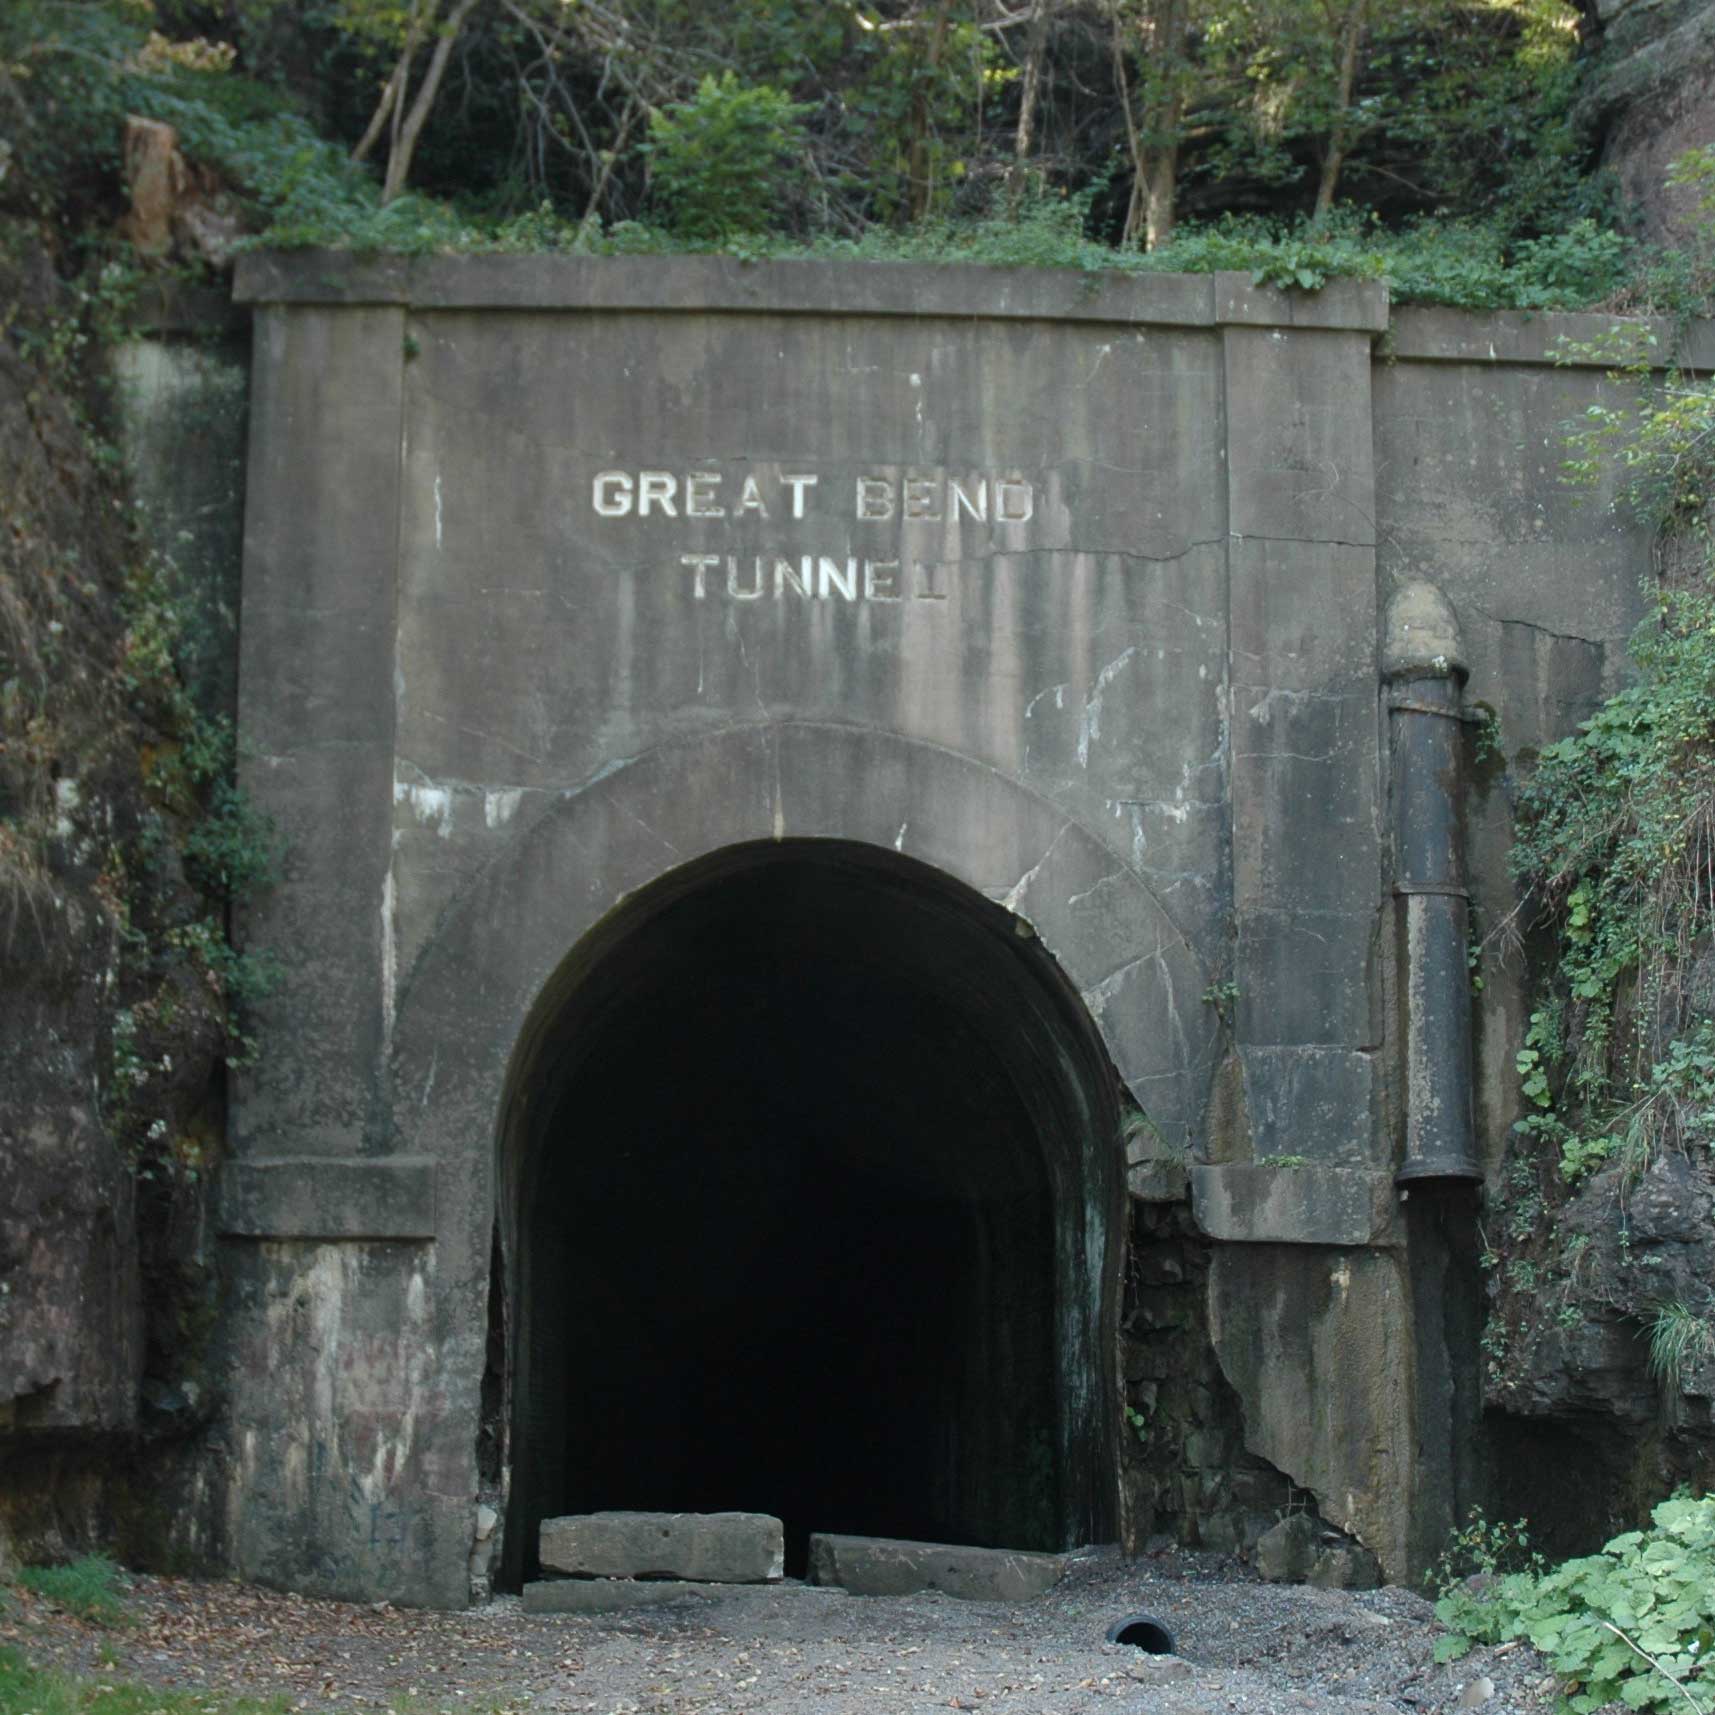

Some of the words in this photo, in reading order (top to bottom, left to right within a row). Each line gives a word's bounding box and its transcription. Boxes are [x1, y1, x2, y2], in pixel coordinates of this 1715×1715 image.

[593, 470, 818, 519] GREAT
[856, 476, 1034, 523] BEND
[680, 553, 948, 602] TUNNEL
